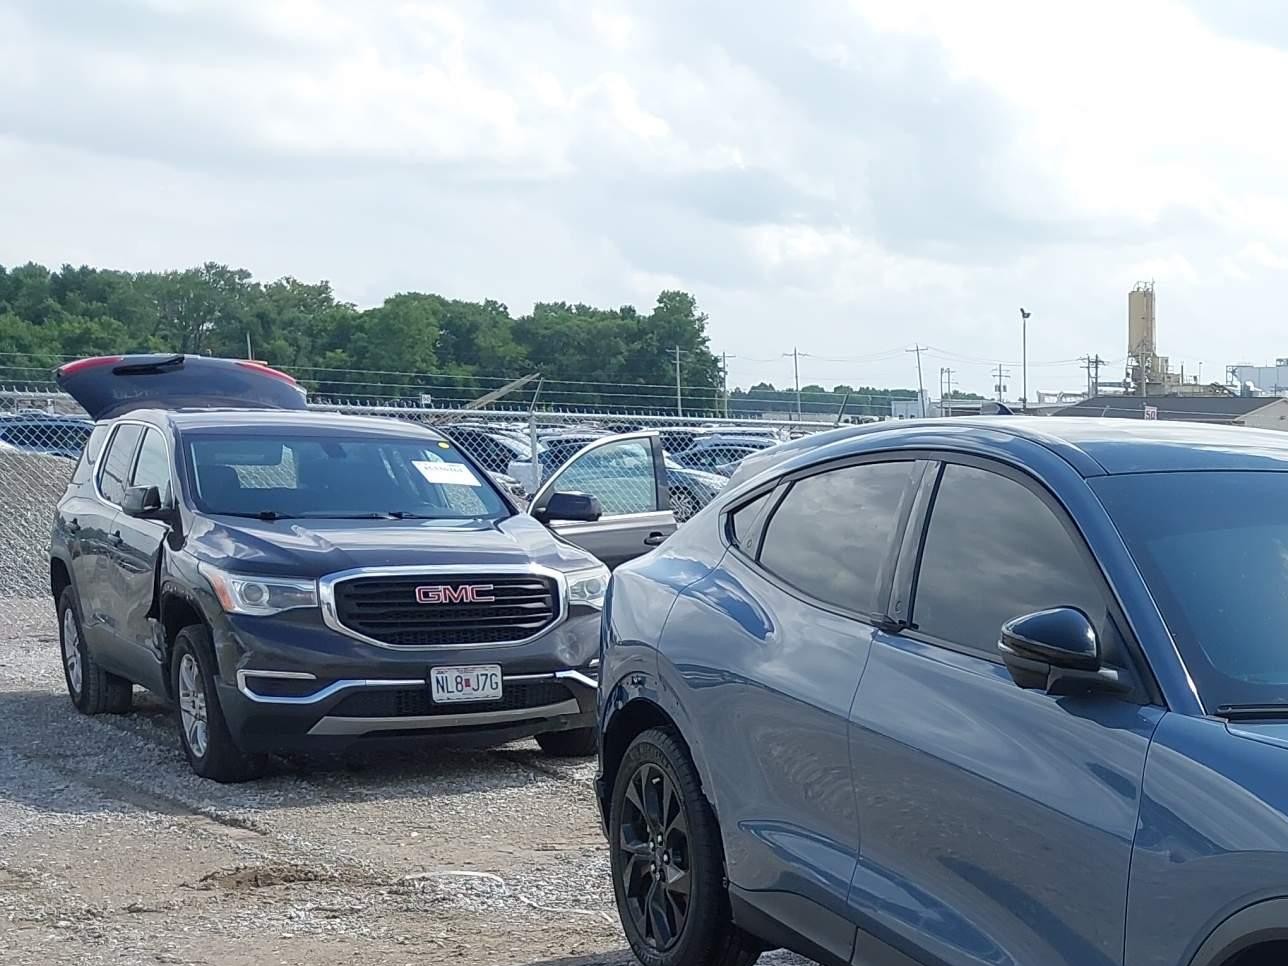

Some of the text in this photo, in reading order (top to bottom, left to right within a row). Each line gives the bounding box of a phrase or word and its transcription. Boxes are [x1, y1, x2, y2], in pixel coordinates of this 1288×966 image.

[415, 584, 495, 603] GMC
[435, 672, 499, 694] NL8 J7G
